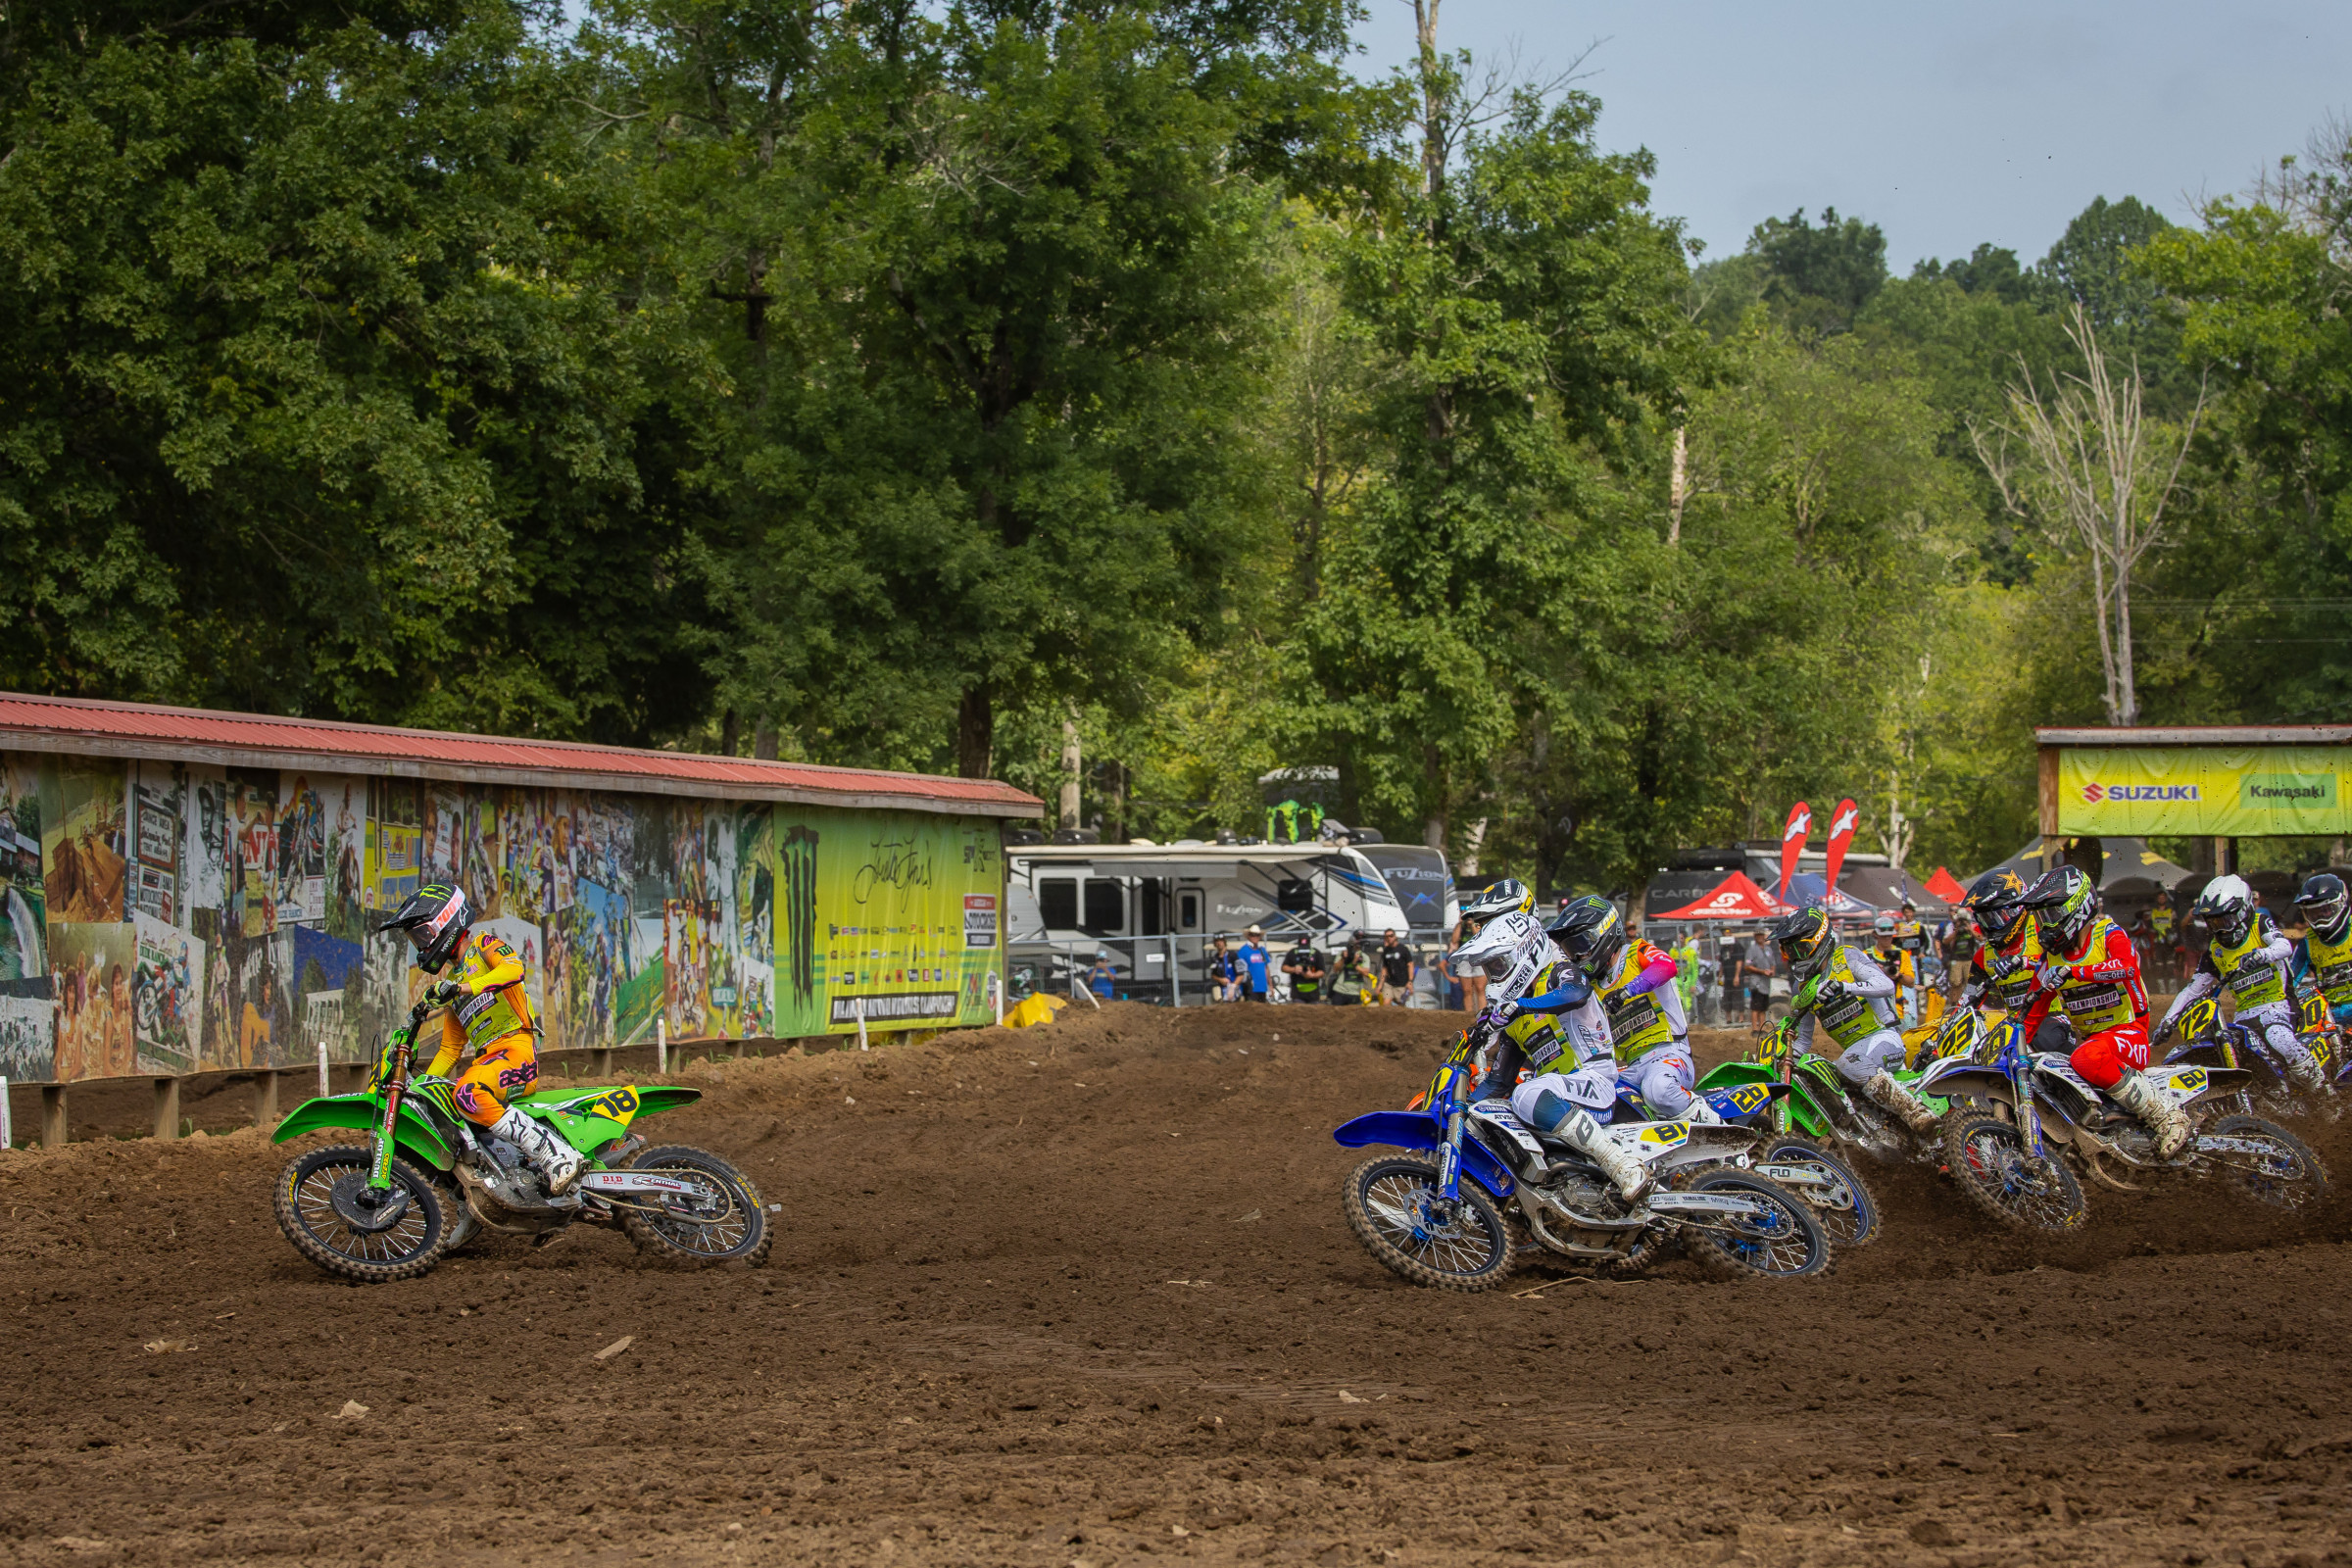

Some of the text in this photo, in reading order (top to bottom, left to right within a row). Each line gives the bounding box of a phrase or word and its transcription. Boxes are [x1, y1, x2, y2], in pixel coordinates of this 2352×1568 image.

[2108, 785, 2197, 801] SUZUKI
[2250, 785, 2326, 799] Kawasaki
[2092, 959, 2123, 970] FXR
[2068, 992, 2117, 1010] CHAMPIONSHIP
[2180, 1001, 2211, 1040] 72
[2114, 1036, 2147, 1066] FXR
[2178, 1069, 2206, 1088] 60
[596, 1090, 638, 1118] 18
[1730, 1085, 1765, 1110] 26
[1654, 1122, 1689, 1142] 81
[373, 1137, 384, 1179] DUNLOP
[1769, 1168, 1791, 1178] FLO
